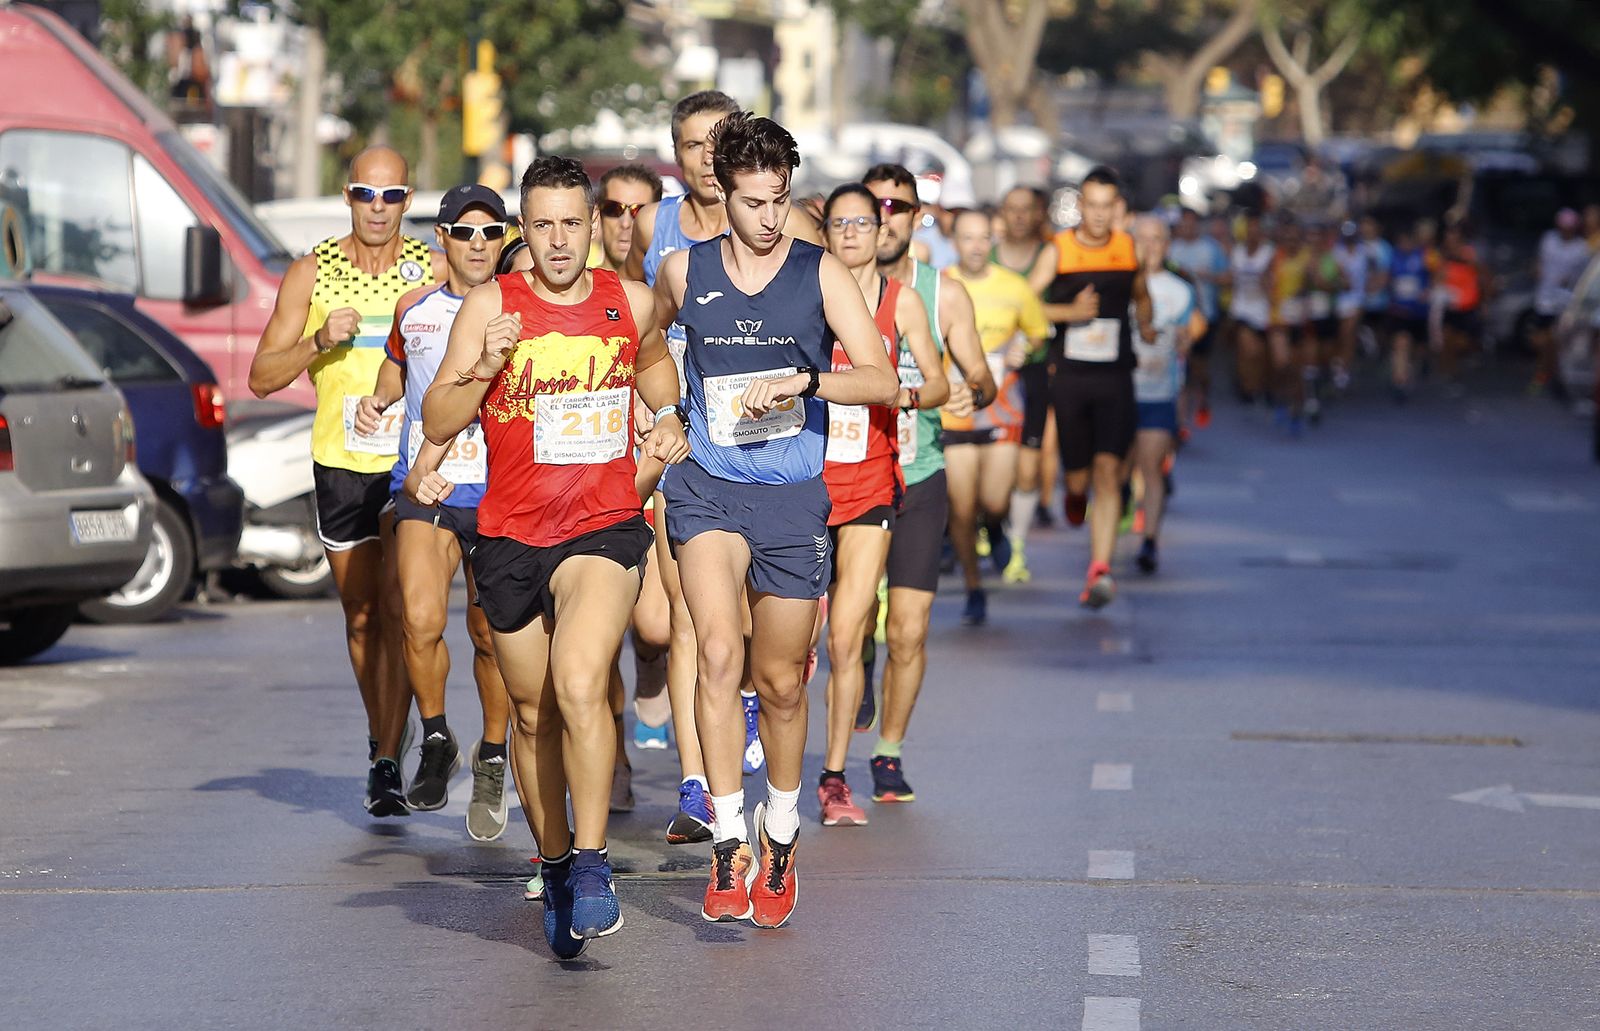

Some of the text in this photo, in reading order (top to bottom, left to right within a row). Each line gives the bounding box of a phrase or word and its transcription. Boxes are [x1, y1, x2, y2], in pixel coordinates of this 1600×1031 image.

[703, 336, 796, 346] PINRELINA
[562, 402, 592, 410] TORCAL
[560, 408, 622, 436] 218
[728, 427, 768, 438] DISMOAUTO
